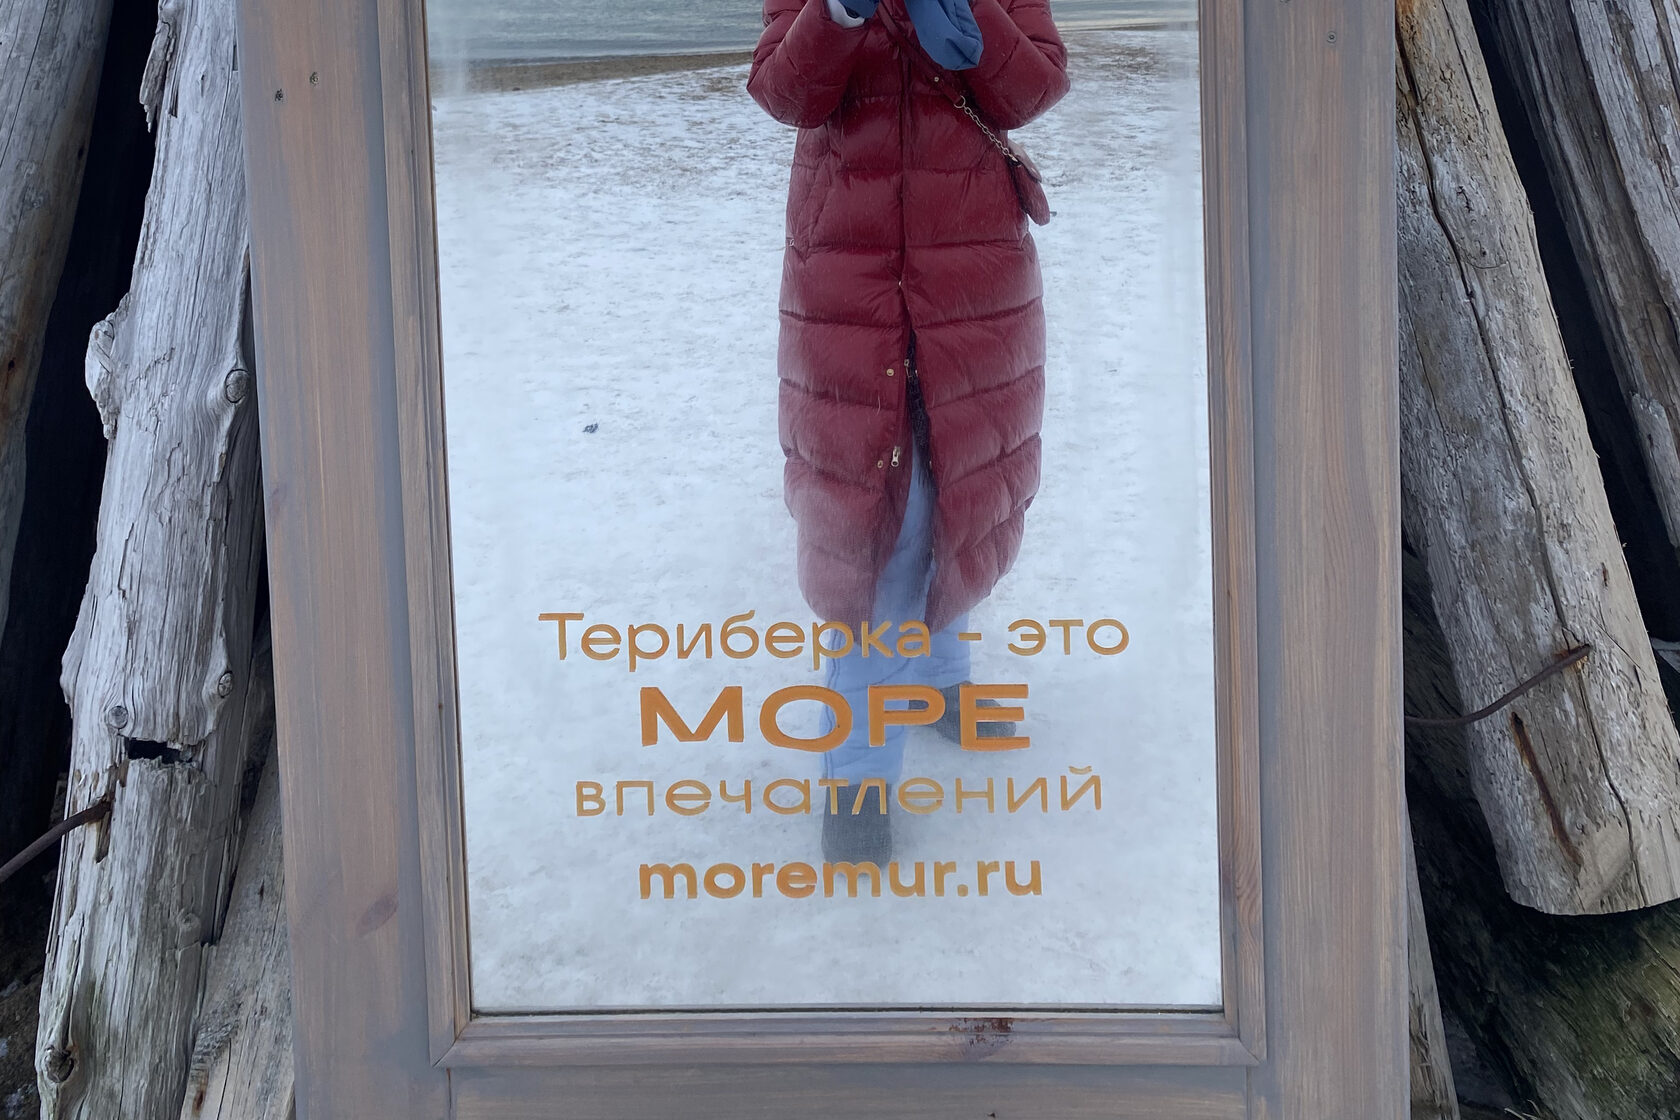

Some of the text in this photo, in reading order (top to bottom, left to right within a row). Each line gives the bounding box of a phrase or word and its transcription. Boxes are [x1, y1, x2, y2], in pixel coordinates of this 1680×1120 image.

[538, 610, 931, 672] Териберка
[1007, 618, 1130, 657] это
[640, 684, 1030, 752] МОРЕ
[575, 765, 1102, 817] впечатлений
[639, 859, 1043, 899] moremur.ru
